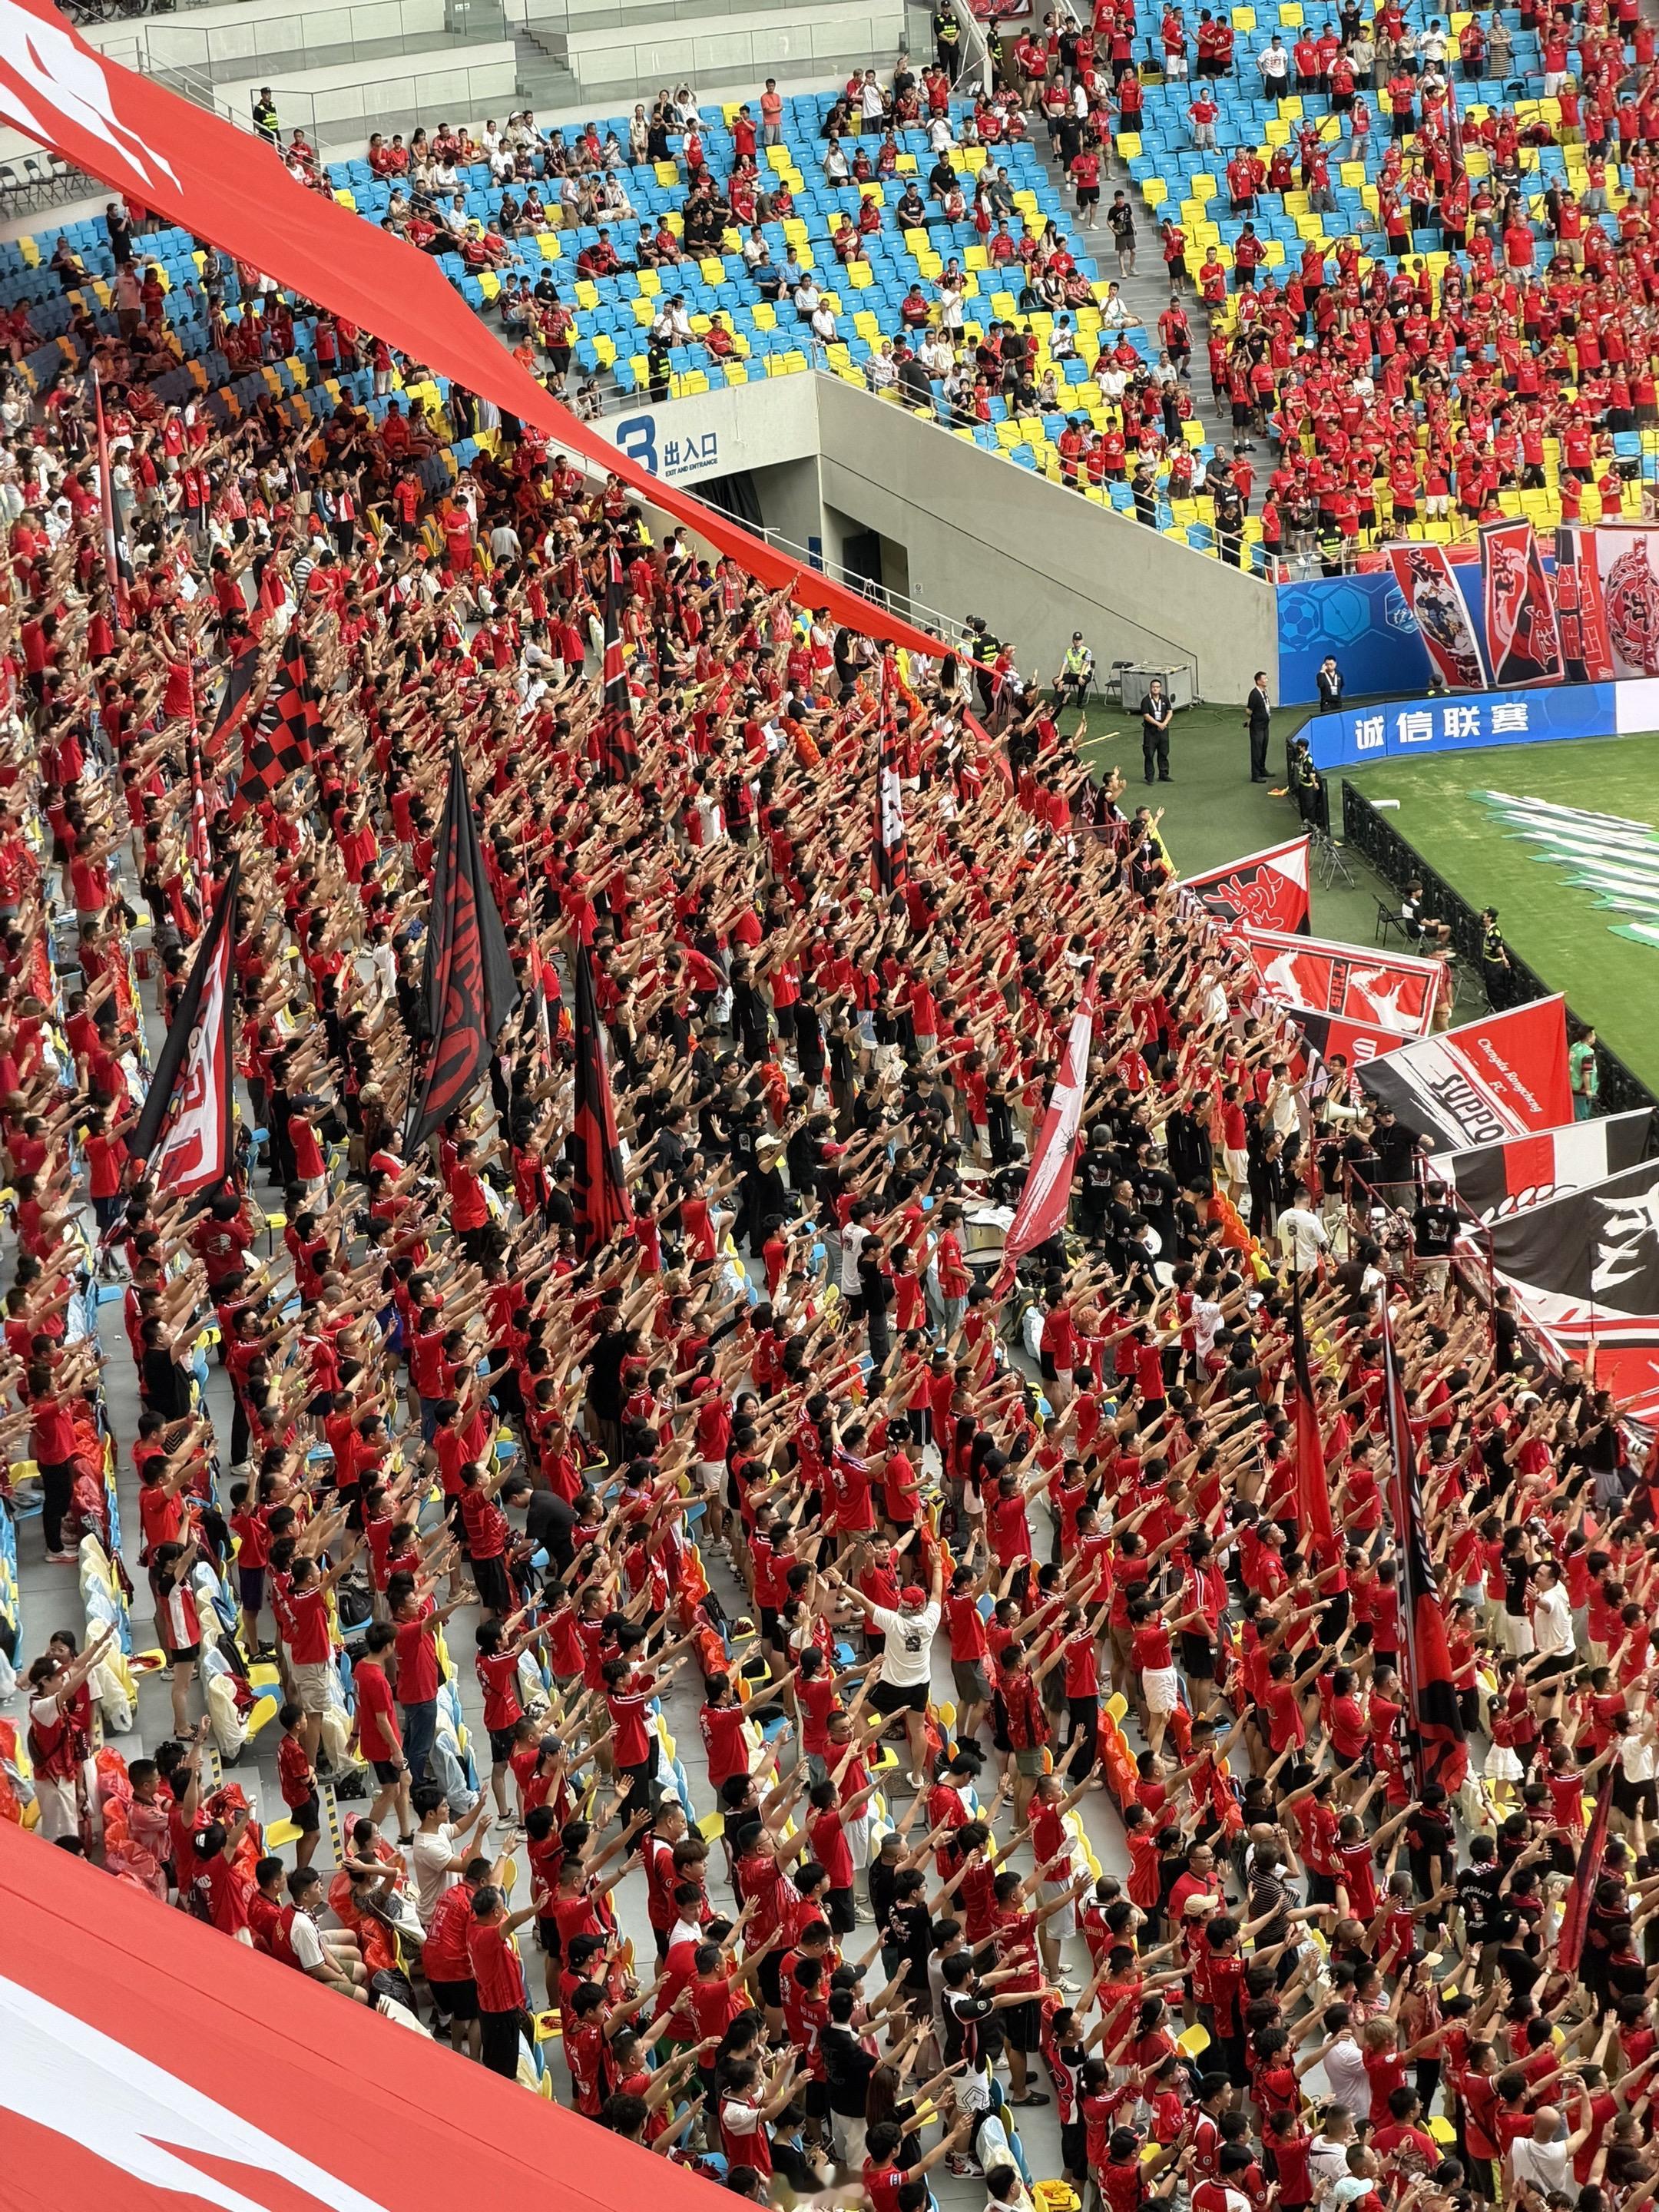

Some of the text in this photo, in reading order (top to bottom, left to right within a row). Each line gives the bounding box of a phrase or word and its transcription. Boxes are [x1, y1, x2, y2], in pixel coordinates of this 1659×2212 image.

[616, 414, 658, 477] 3
[664, 432, 718, 467] 出入口
[689, 458, 718, 469] ENTRANCE
[1355, 702, 1529, 750] 诚信联赛
[1477, 1038, 1542, 1113] Chengdu Rongcheng
[1488, 1081, 1508, 1094] FC
[1429, 1074, 1511, 1144] SUPPO
